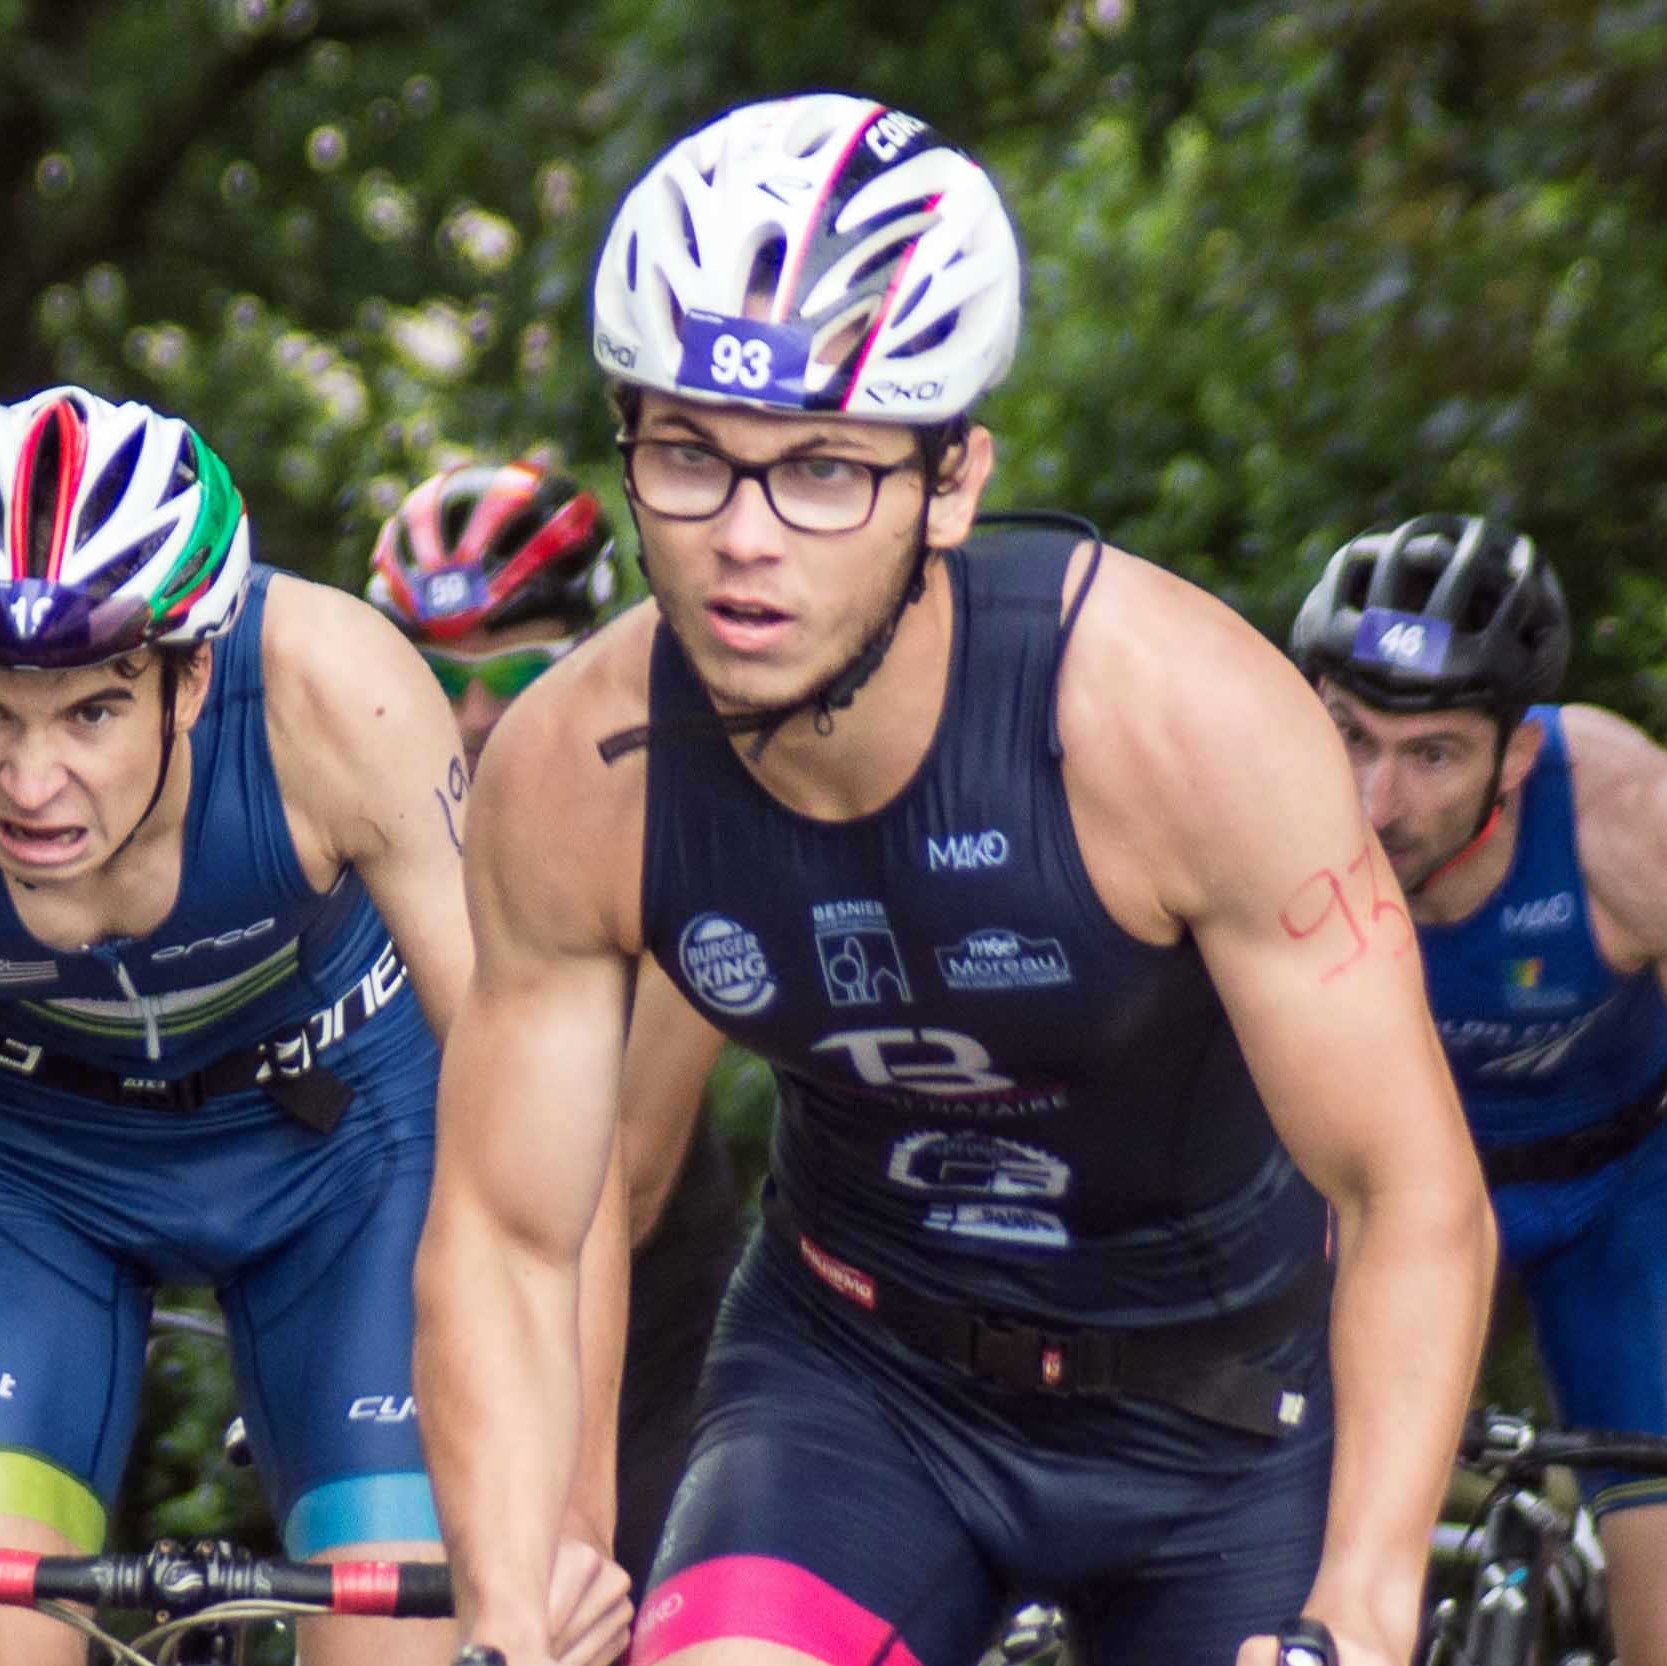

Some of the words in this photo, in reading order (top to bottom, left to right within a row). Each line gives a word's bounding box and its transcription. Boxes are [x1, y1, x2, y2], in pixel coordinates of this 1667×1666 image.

[710, 334, 774, 389] 93
[1377, 622, 1424, 659] 46
[151, 917, 276, 961] orca
[686, 932, 759, 964] BURGER
[694, 952, 768, 988] KING
[948, 954, 1057, 977] Moreau
